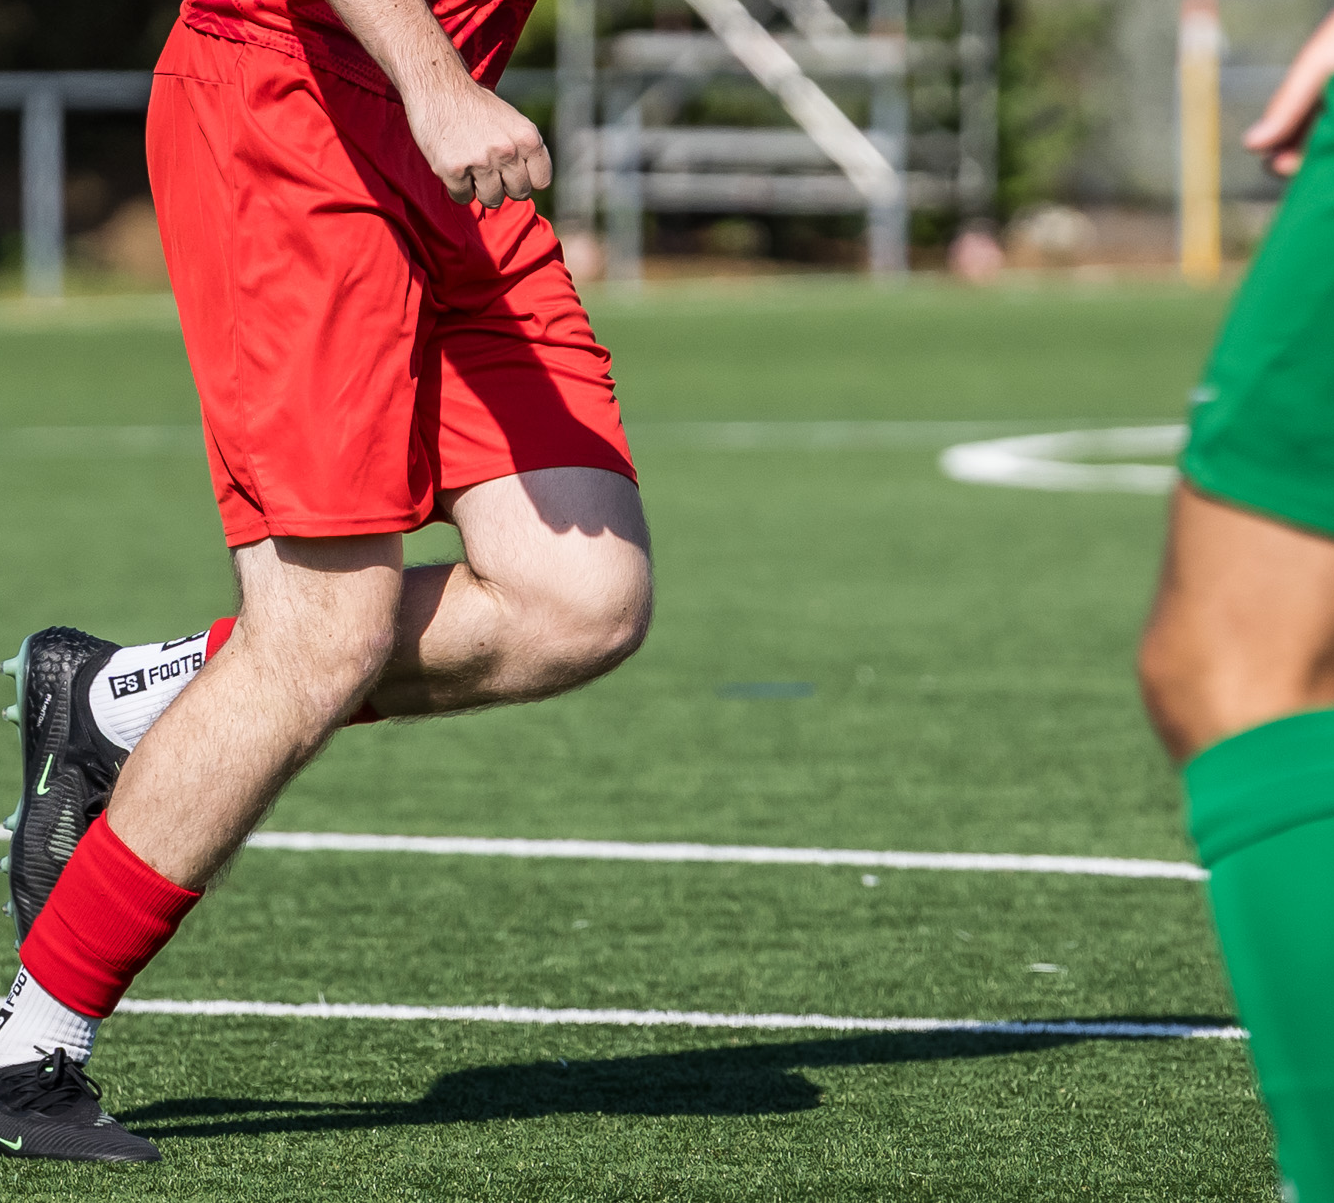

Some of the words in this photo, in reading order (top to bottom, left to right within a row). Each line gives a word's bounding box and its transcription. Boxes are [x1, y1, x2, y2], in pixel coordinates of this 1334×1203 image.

[111, 673, 141, 697] FS
[148, 652, 206, 685] FOOTB
[6, 966, 27, 1008] FOO
